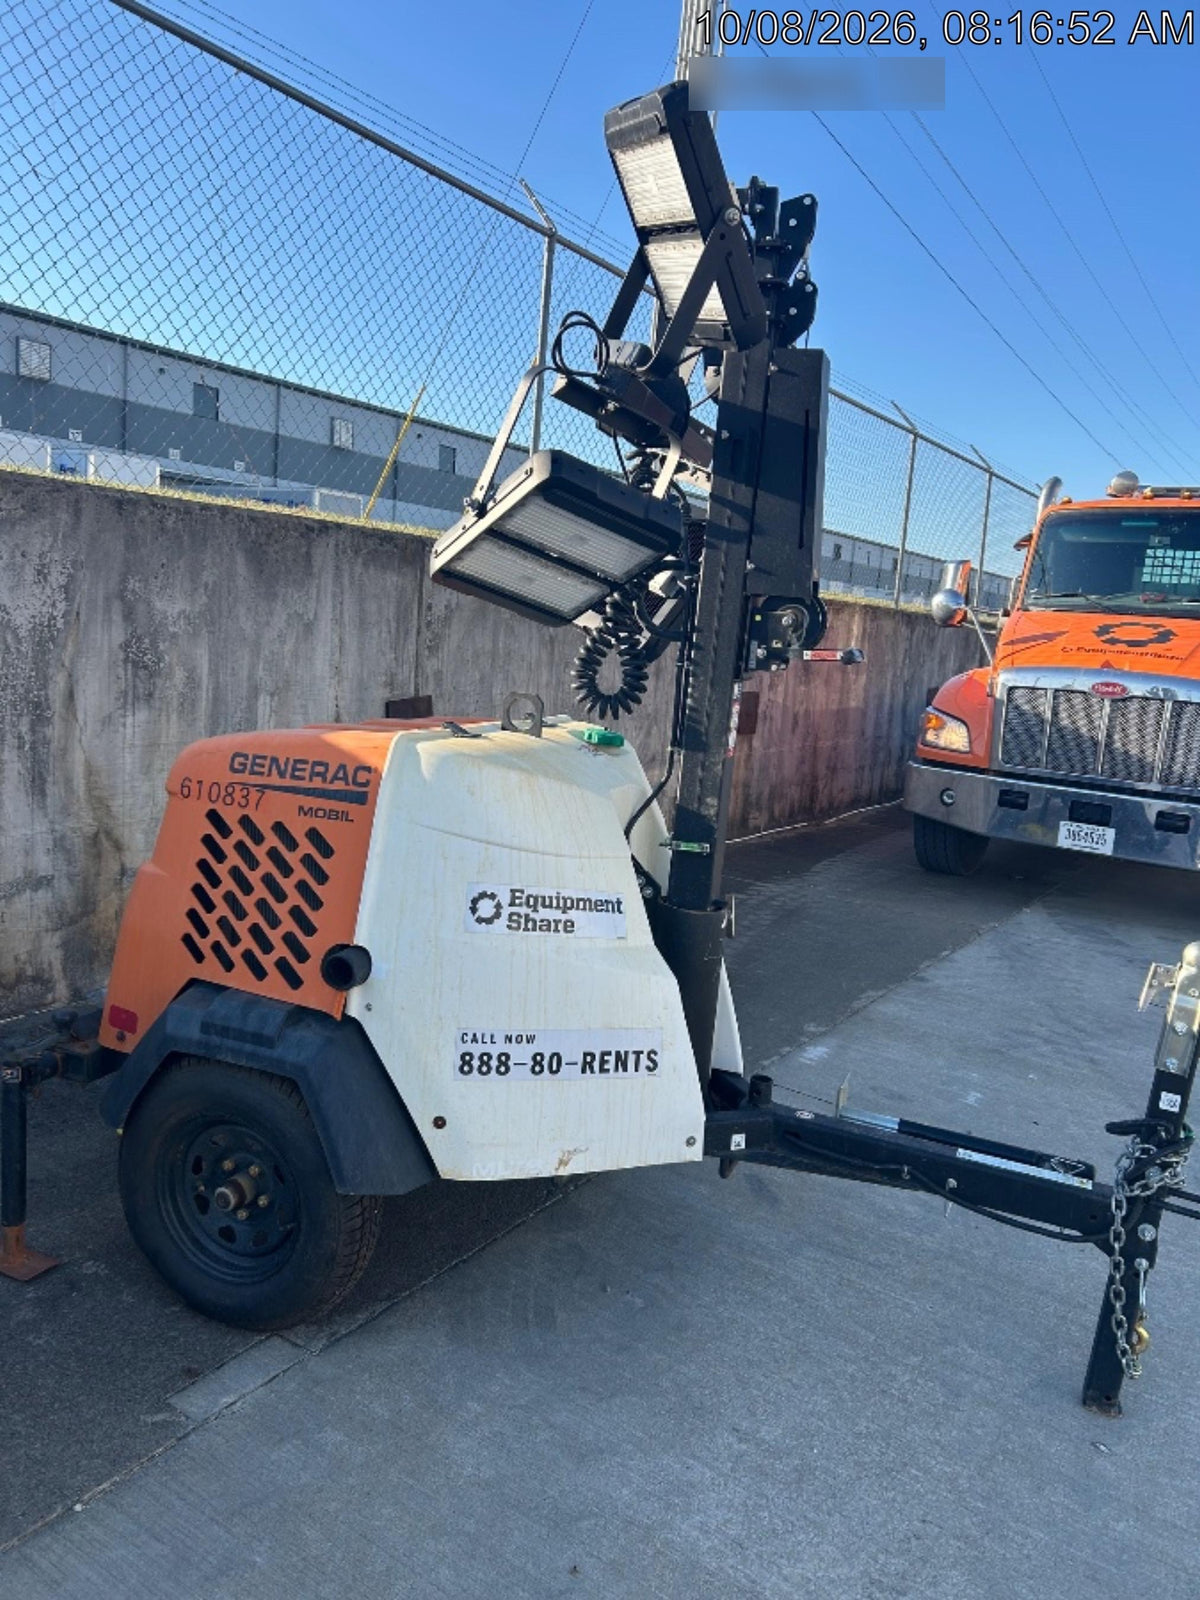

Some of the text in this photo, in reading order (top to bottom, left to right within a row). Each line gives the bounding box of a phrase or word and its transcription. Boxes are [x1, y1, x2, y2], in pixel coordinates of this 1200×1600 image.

[229, 752, 372, 788] GENERAC
[180, 777, 266, 811] 610837
[298, 805, 354, 822] MOBIL
[508, 888, 624, 914] Equipment
[506, 912, 576, 933] Share
[461, 1032, 536, 1044] CALL NOW
[458, 1049, 659, 1076] 888-80-RENTS
